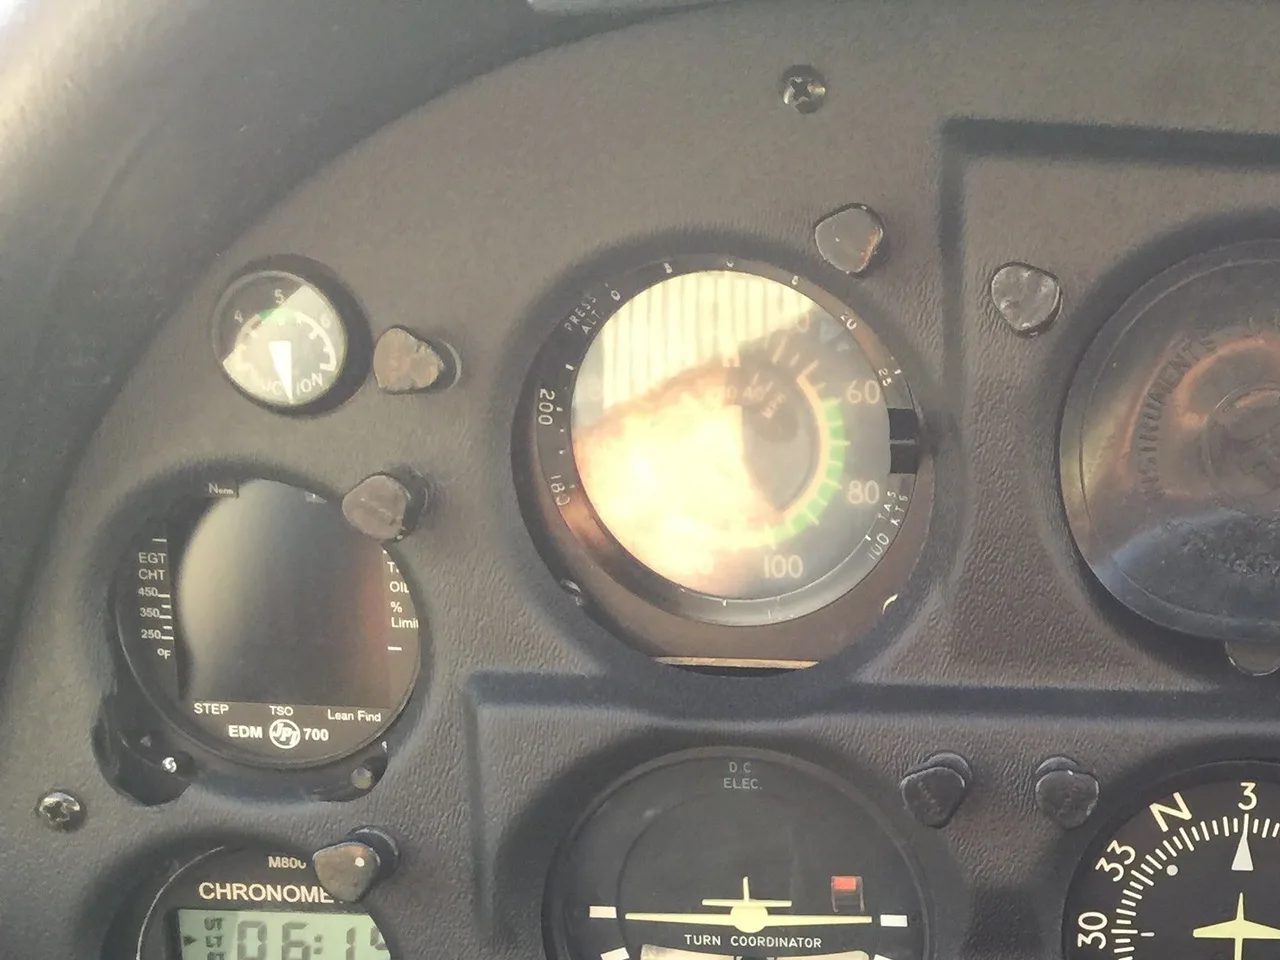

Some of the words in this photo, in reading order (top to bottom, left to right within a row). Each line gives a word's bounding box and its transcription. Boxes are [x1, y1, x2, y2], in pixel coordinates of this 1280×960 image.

[846, 381, 881, 405] 60
[538, 388, 555, 426] 200
[847, 480, 881, 504] 80
[138, 552, 166, 564] EGT
[763, 555, 804, 579] 100
[138, 569, 166, 581] CHT
[194, 703, 230, 715] STEP
[327, 709, 354, 721] Lean
[357, 711, 381, 722] Find
[228, 725, 263, 739] EDM
[303, 728, 329, 742] 700
[1237, 782, 1258, 811] 3
[1148, 792, 1192, 832] N
[684, 934, 721, 946] TURN
[730, 936, 822, 948] COORDINATOR
